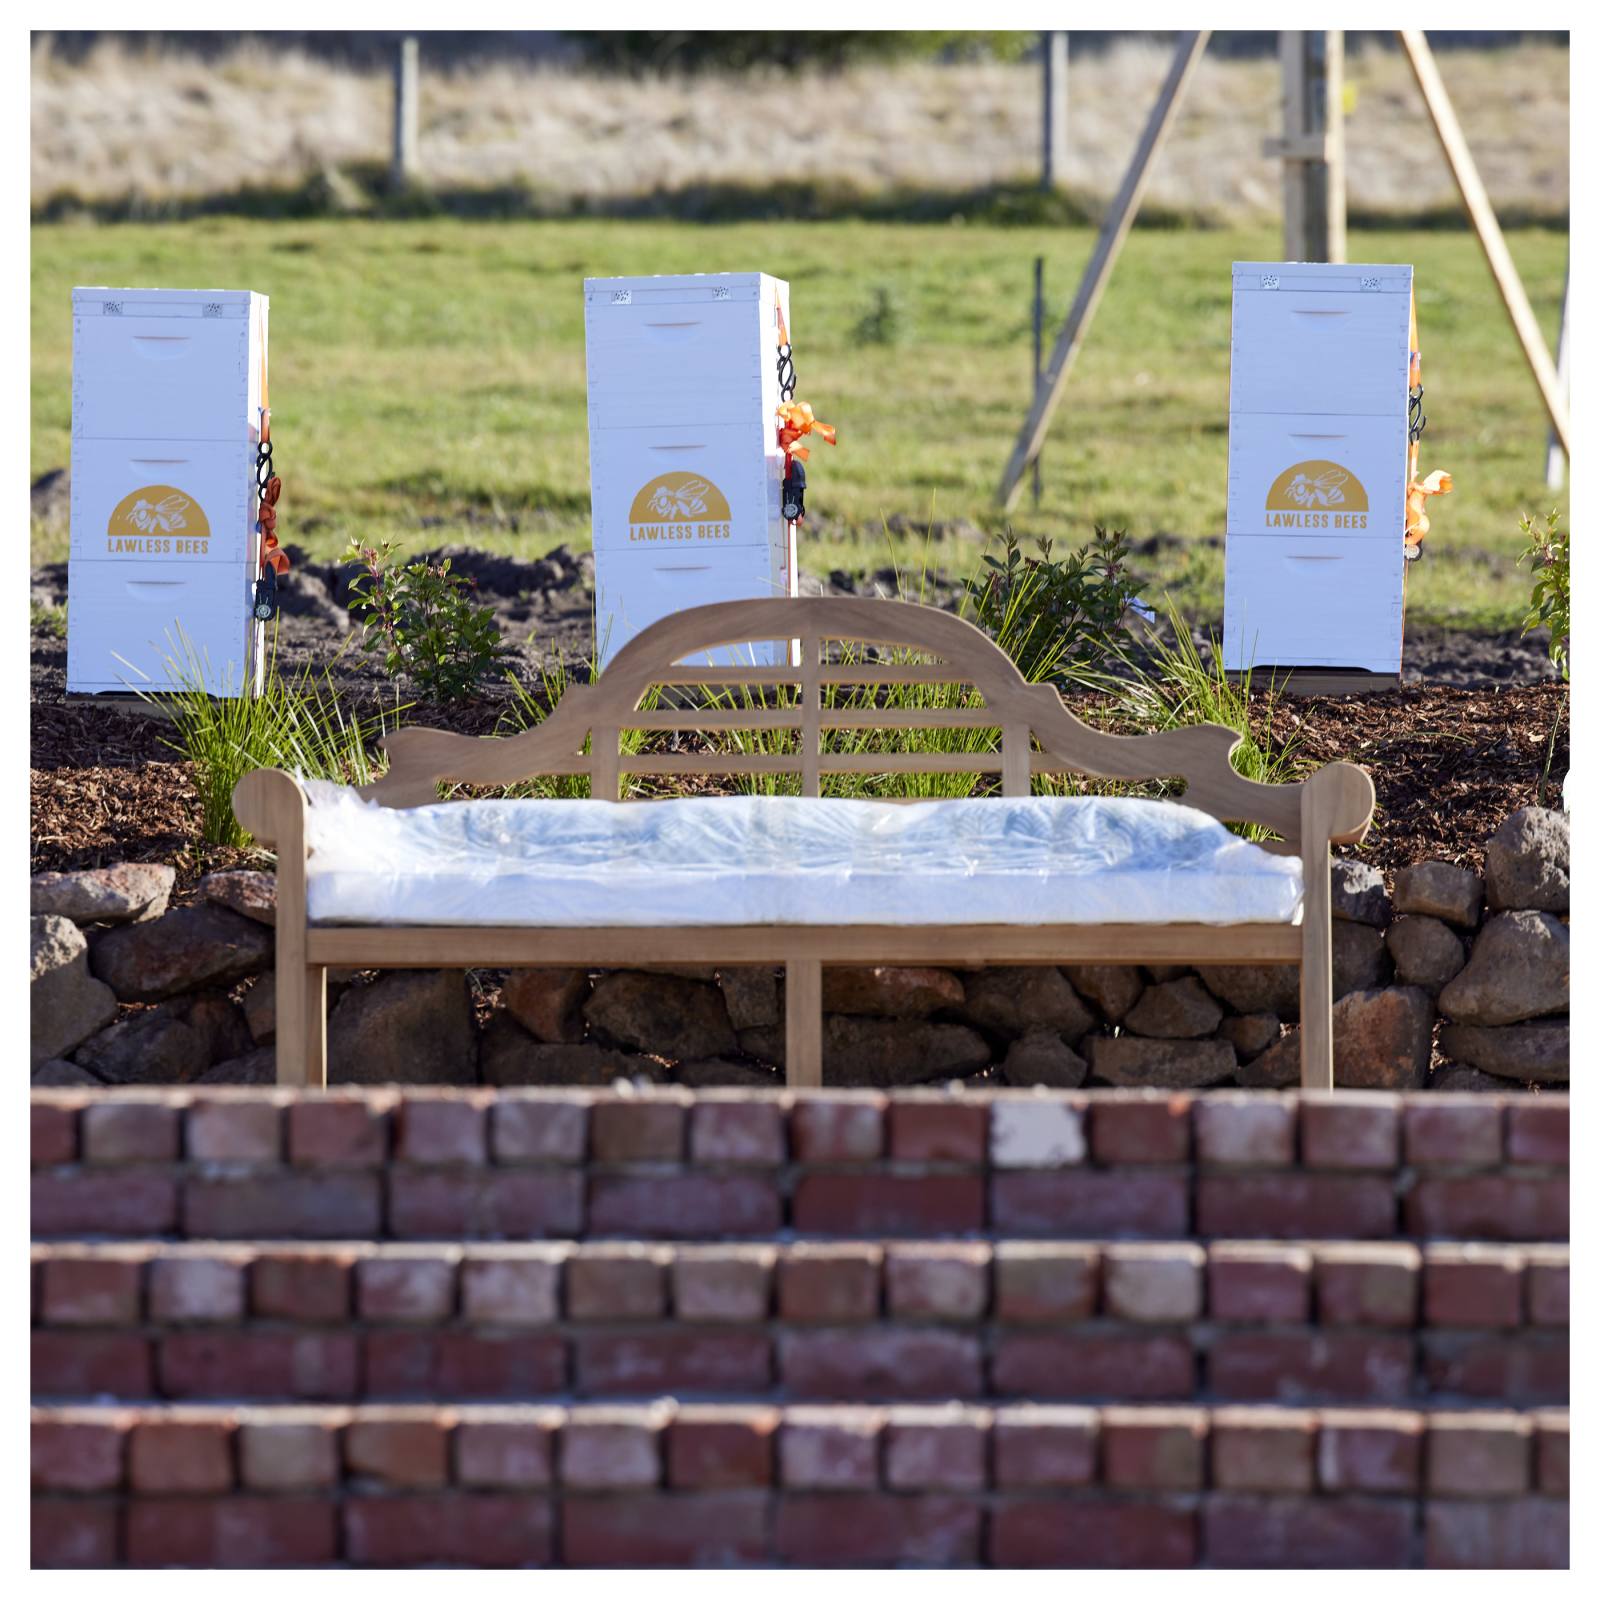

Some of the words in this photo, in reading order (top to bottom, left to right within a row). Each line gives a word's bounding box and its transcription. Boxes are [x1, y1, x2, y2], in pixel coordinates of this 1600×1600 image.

[1266, 513, 1328, 528] LAWLESS
[1334, 514, 1367, 529] BEES
[629, 525, 692, 541] LAWLESS
[698, 524, 730, 539] BEES
[107, 538, 170, 553] LAWLESS
[176, 539, 209, 554] BEES
